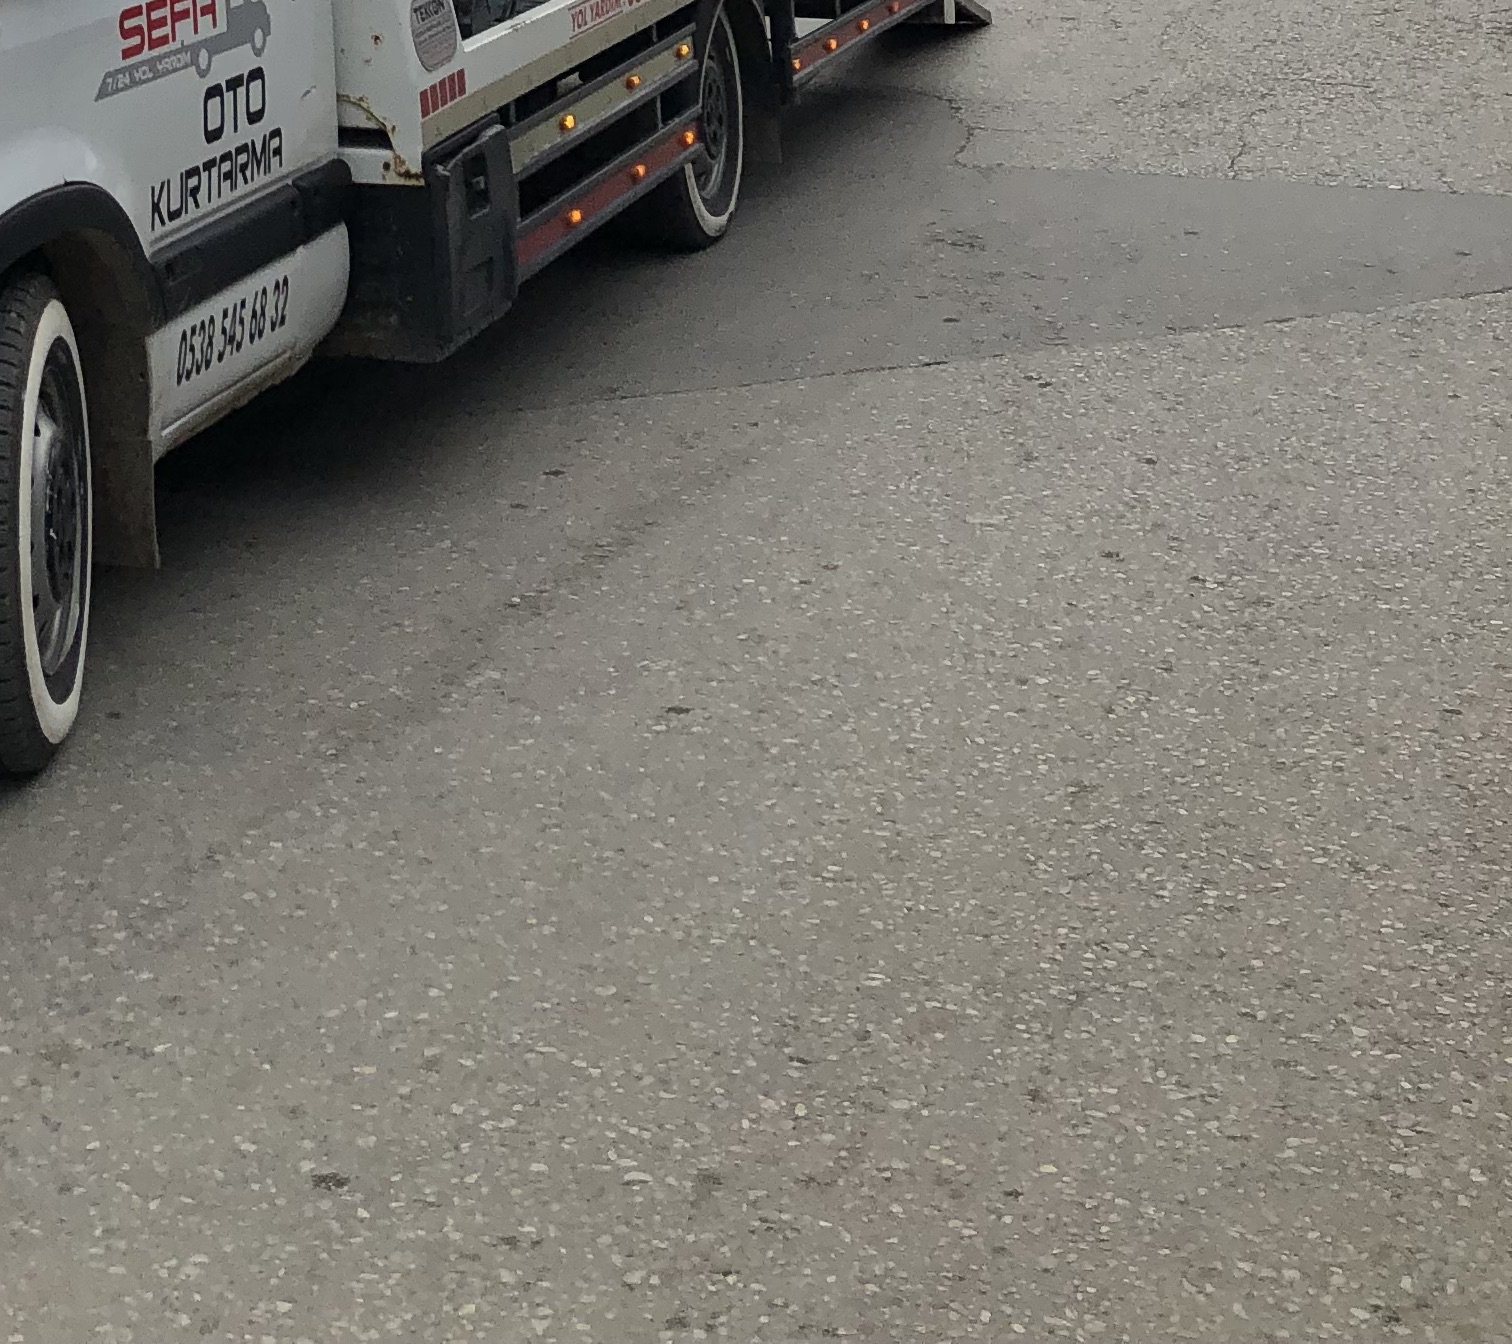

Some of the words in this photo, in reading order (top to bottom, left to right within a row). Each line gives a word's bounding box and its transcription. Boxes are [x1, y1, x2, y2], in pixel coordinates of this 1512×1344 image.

[203, 66, 267, 144] OTO
[150, 127, 283, 231] KURTARMA
[176, 315, 215, 386] 0538
[218, 298, 246, 363] 545
[249, 286, 267, 344] 68
[271, 275, 288, 333] 32
